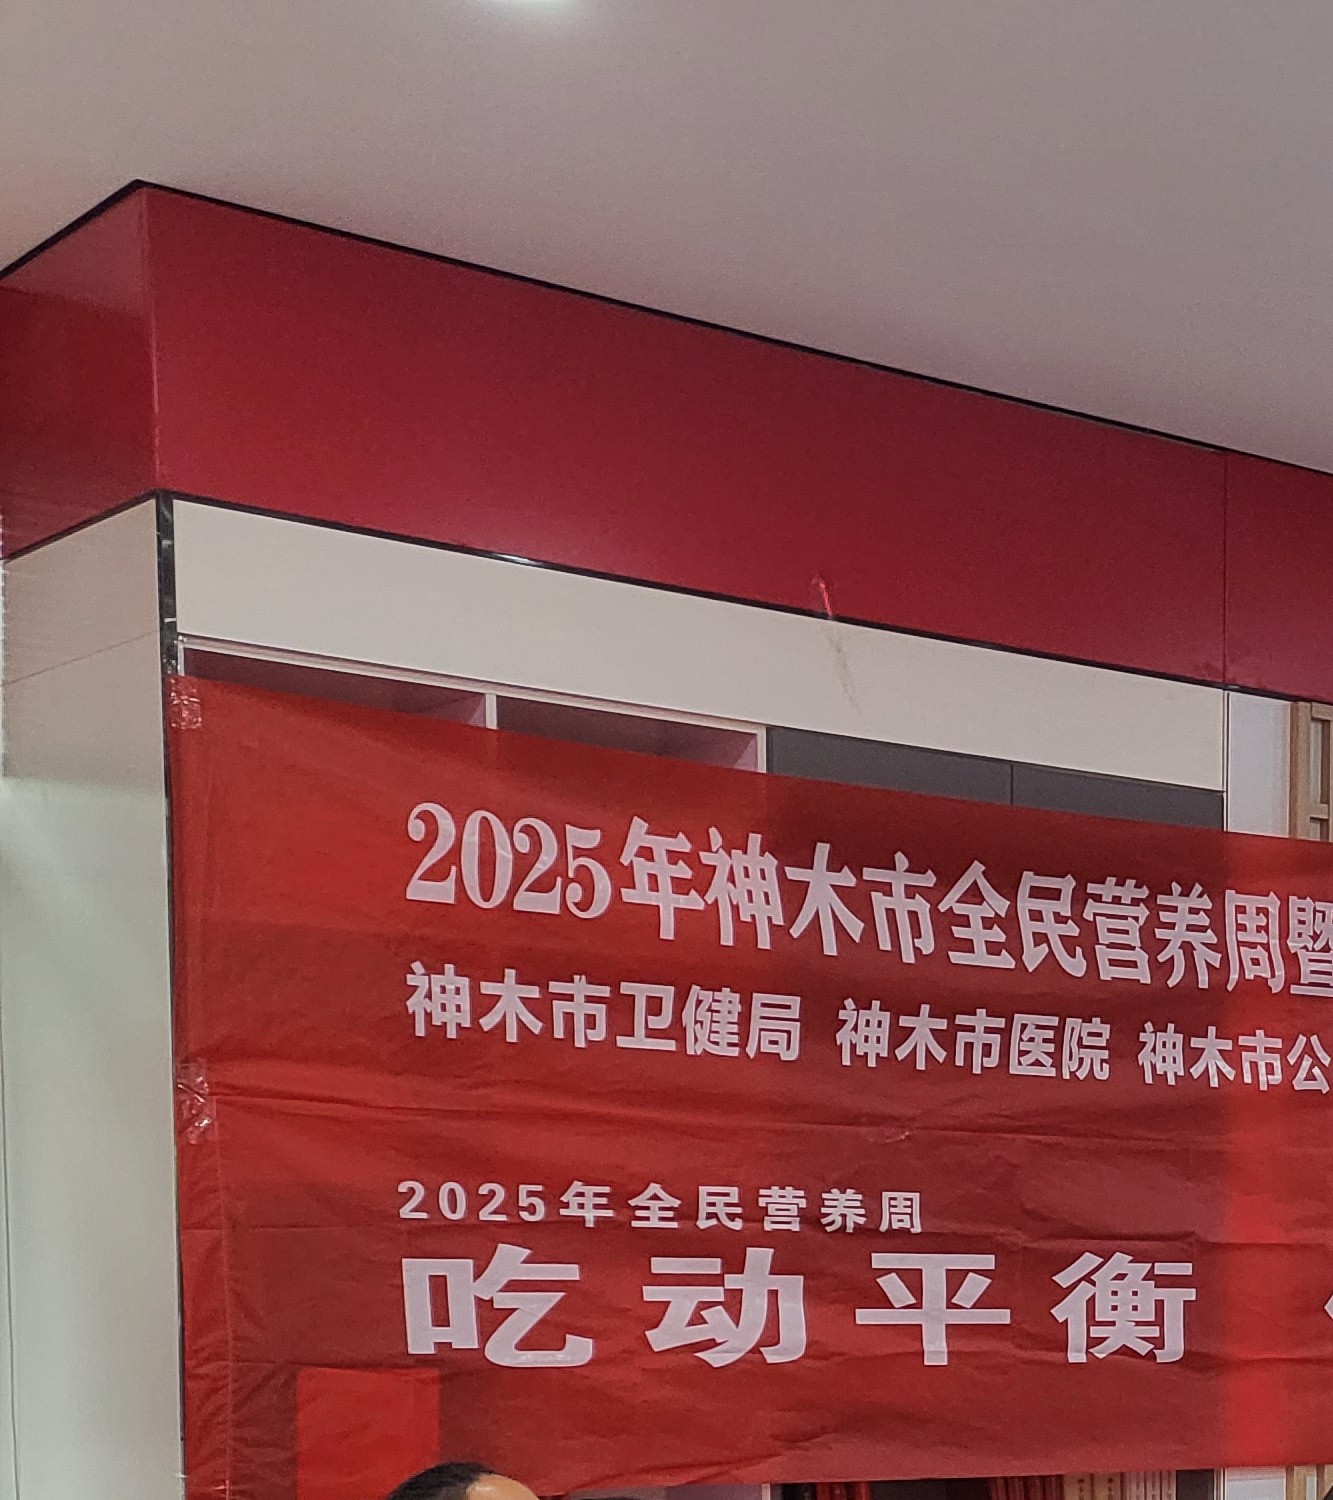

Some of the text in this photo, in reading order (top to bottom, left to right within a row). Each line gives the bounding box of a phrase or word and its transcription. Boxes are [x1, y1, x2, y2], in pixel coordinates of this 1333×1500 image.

[406, 962, 800, 1060] 神木市卫健局
[836, 998, 1110, 1080] 神木市医院
[398, 1181, 921, 1233] 2025年全民营养周
[402, 1244, 1196, 1367] 吃动平衡
